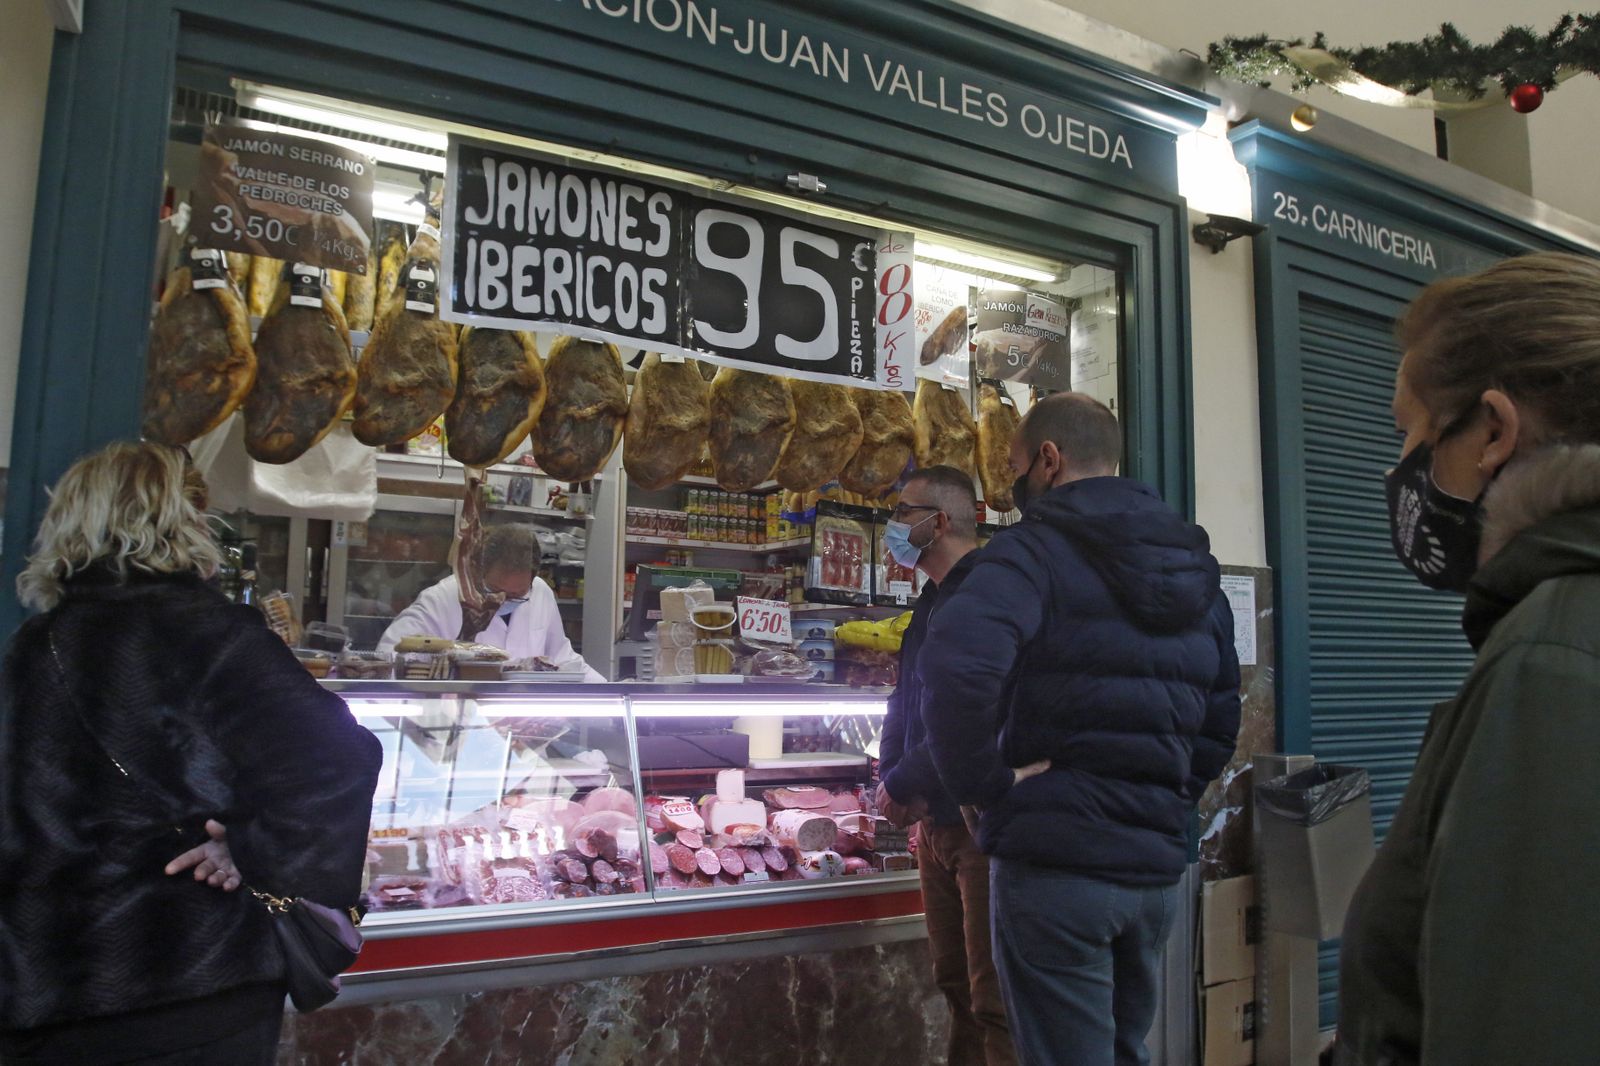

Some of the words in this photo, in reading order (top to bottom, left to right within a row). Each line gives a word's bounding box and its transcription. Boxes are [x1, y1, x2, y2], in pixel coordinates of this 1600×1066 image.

[864, 53, 1009, 127] VALLES
[1020, 104, 1133, 169] OJEDA
[224, 138, 284, 157] JAMÓN
[289, 146, 364, 176] SERRANO
[234, 165, 288, 186] VALLE
[292, 175, 315, 190] DE
[320, 181, 350, 199] LOS
[239, 184, 343, 215] PEDROCHES
[465, 157, 673, 257] JAMONES
[879, 234, 908, 254] de
[694, 208, 840, 361] 95
[878, 263, 913, 326] 8
[1003, 322, 1030, 335] RAZA
